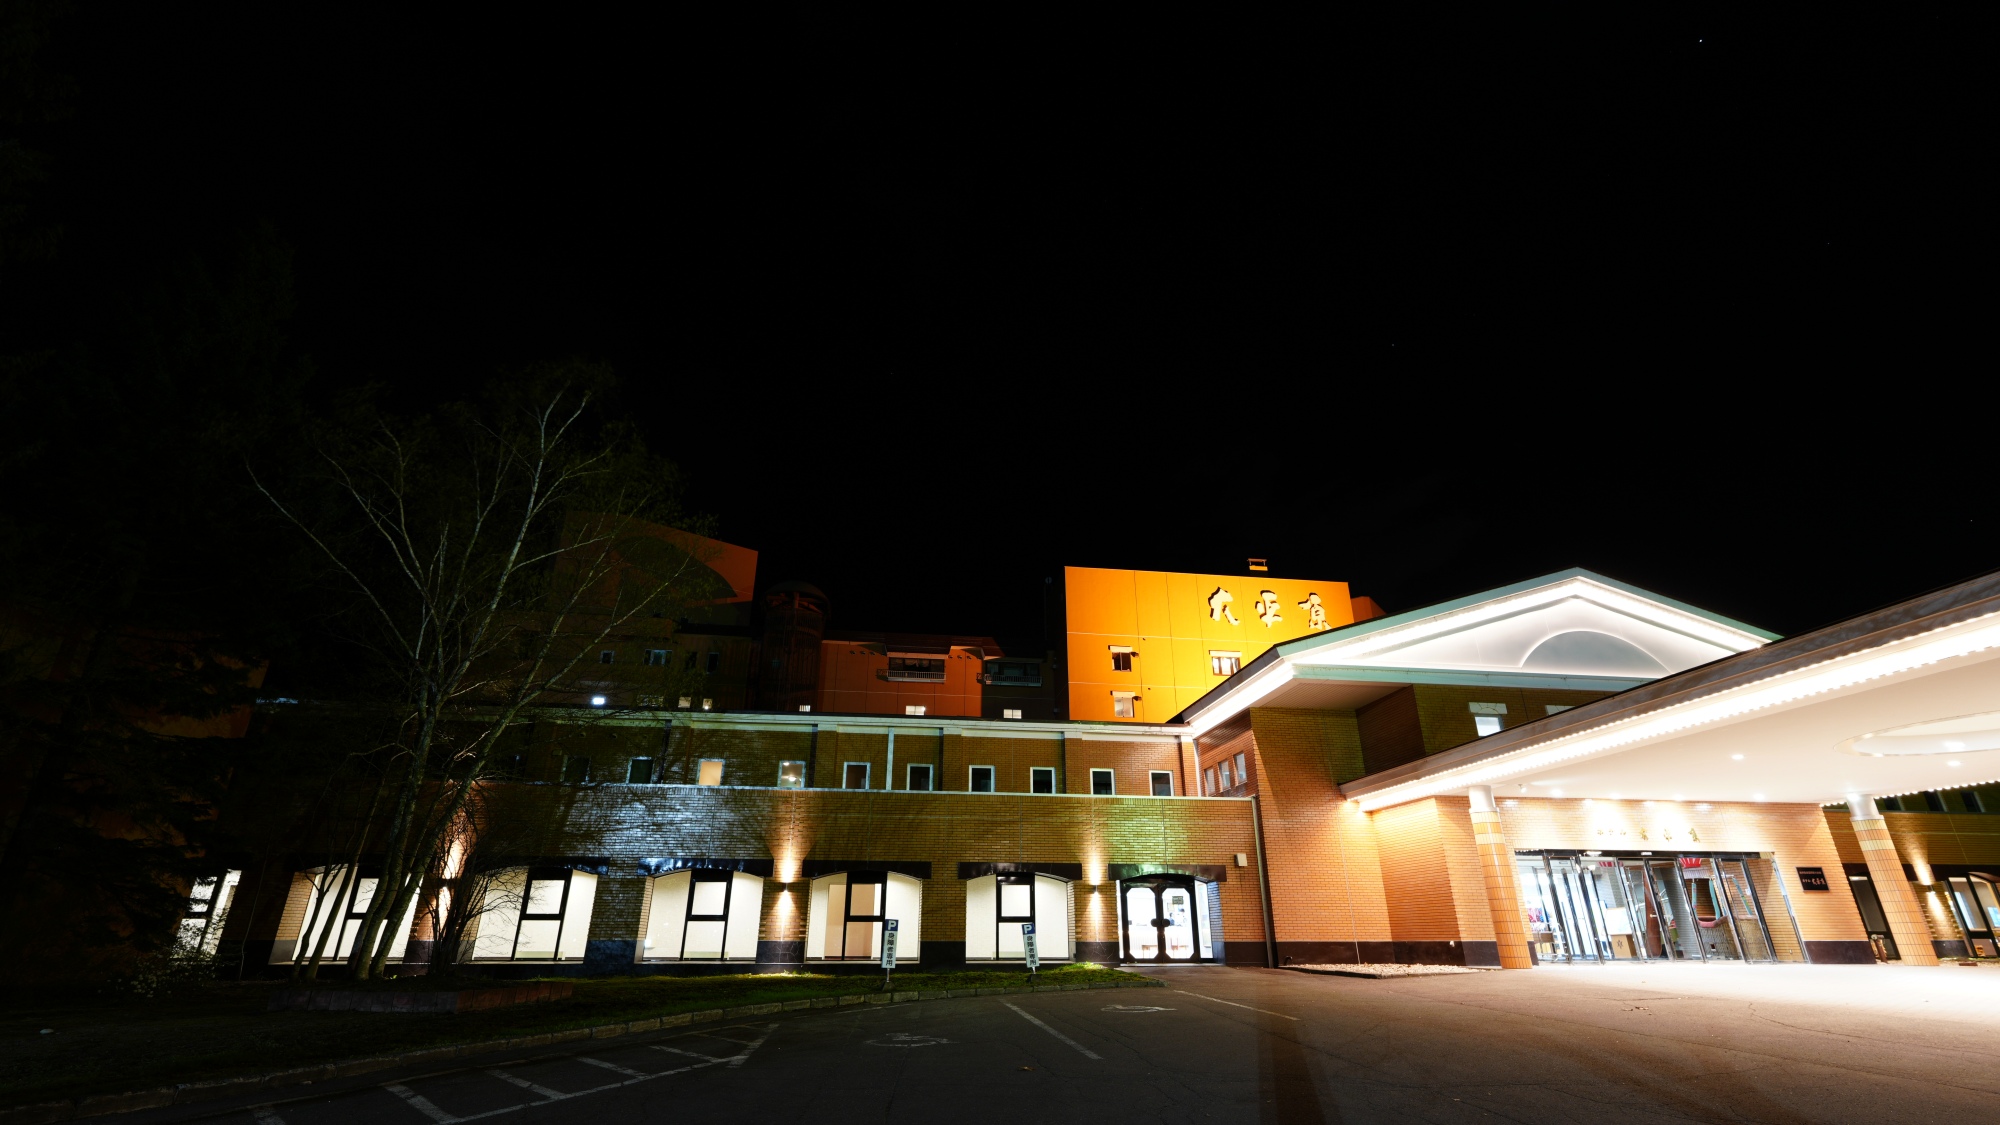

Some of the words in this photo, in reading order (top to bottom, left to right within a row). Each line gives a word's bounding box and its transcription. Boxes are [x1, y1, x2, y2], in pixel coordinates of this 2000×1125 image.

[887, 920, 897, 931] P
[1023, 924, 1033, 934] P
[886, 932, 895, 966] 身障者専用
[1026, 935, 1036, 966] 身障者専用
